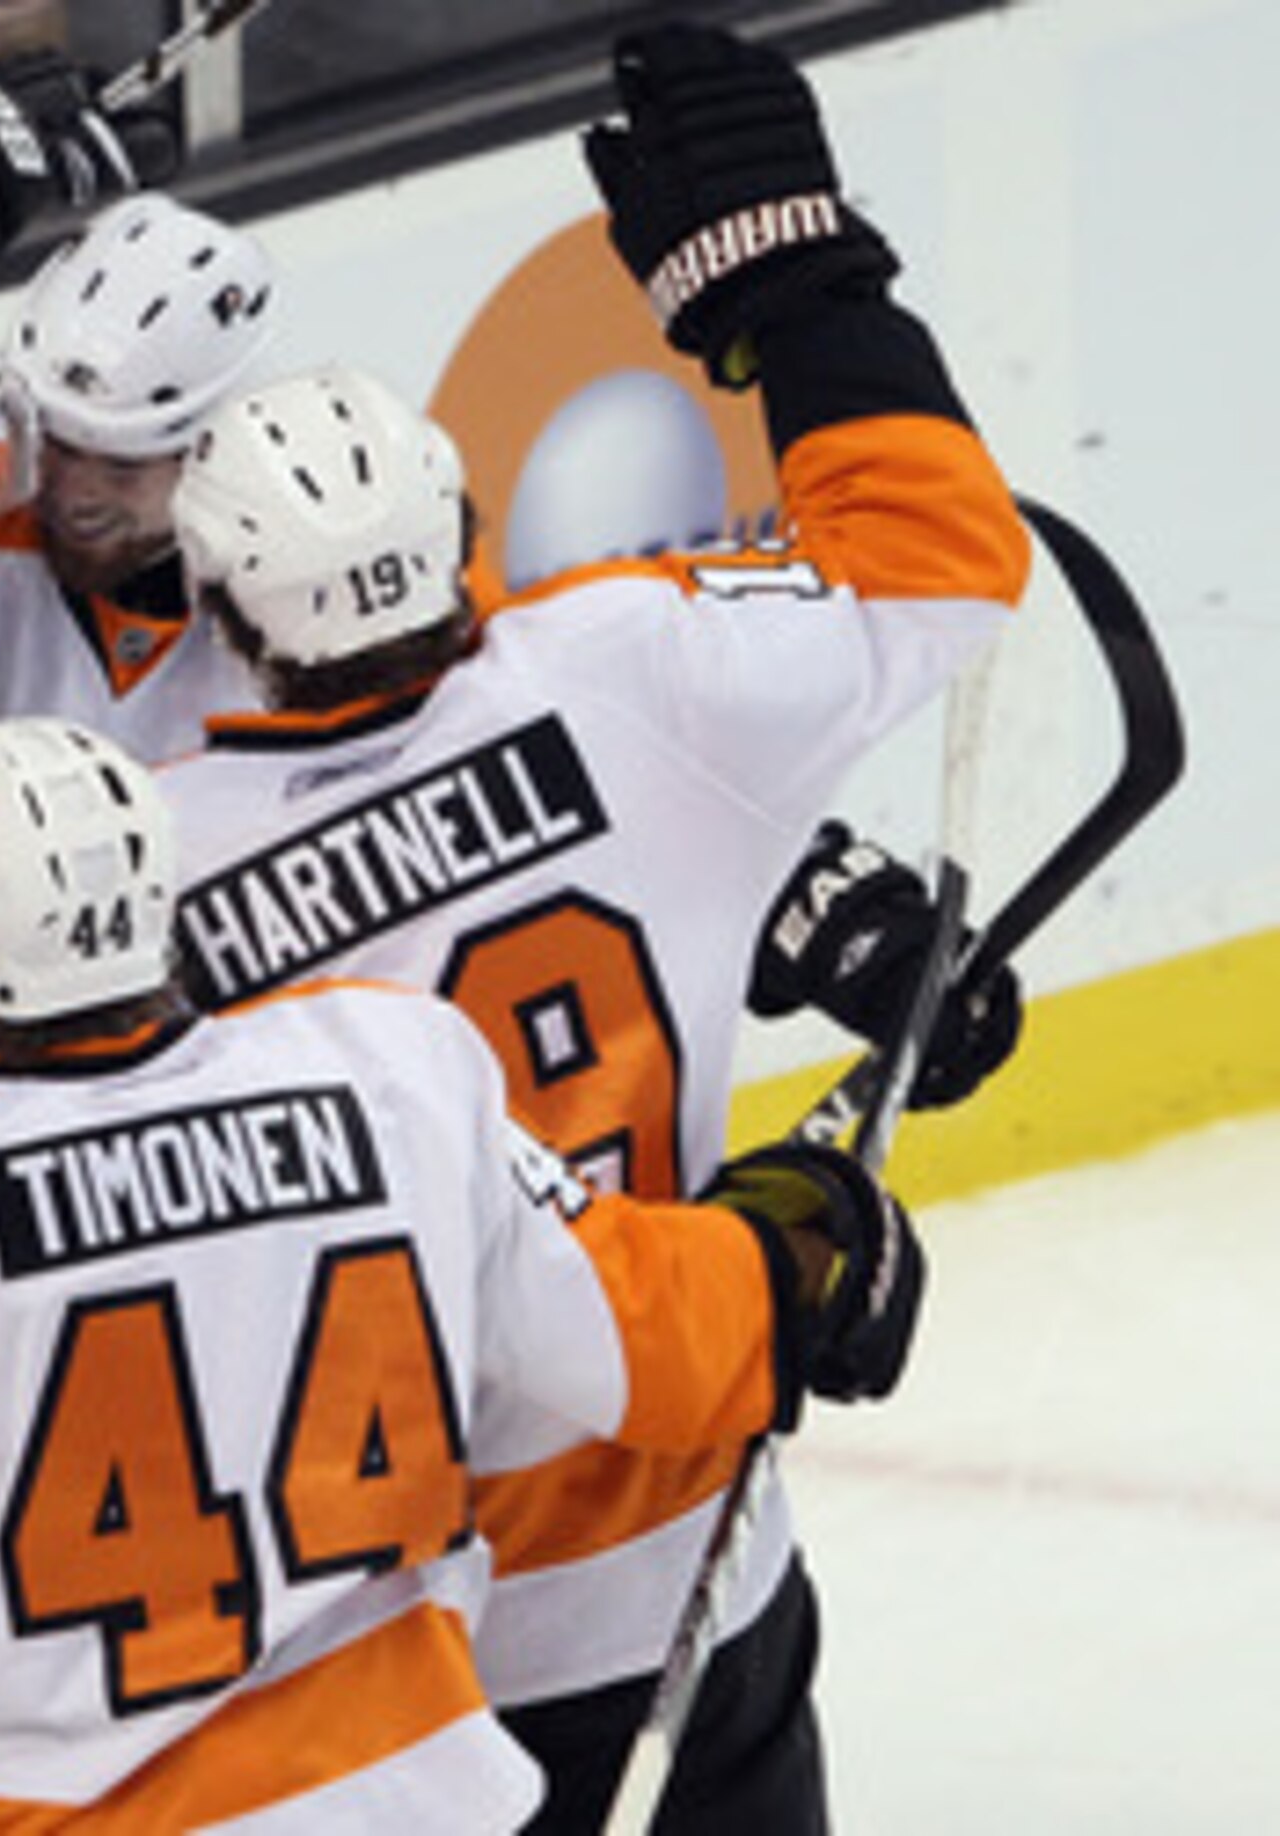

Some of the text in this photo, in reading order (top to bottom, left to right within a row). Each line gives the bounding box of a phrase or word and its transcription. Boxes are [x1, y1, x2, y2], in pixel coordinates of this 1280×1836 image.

[347, 551, 410, 616] 19
[67, 895, 134, 959] 44
[181, 745, 583, 998] HARTNELL
[437, 884, 686, 1203] 9
[7, 1094, 361, 1258] TIMONEN
